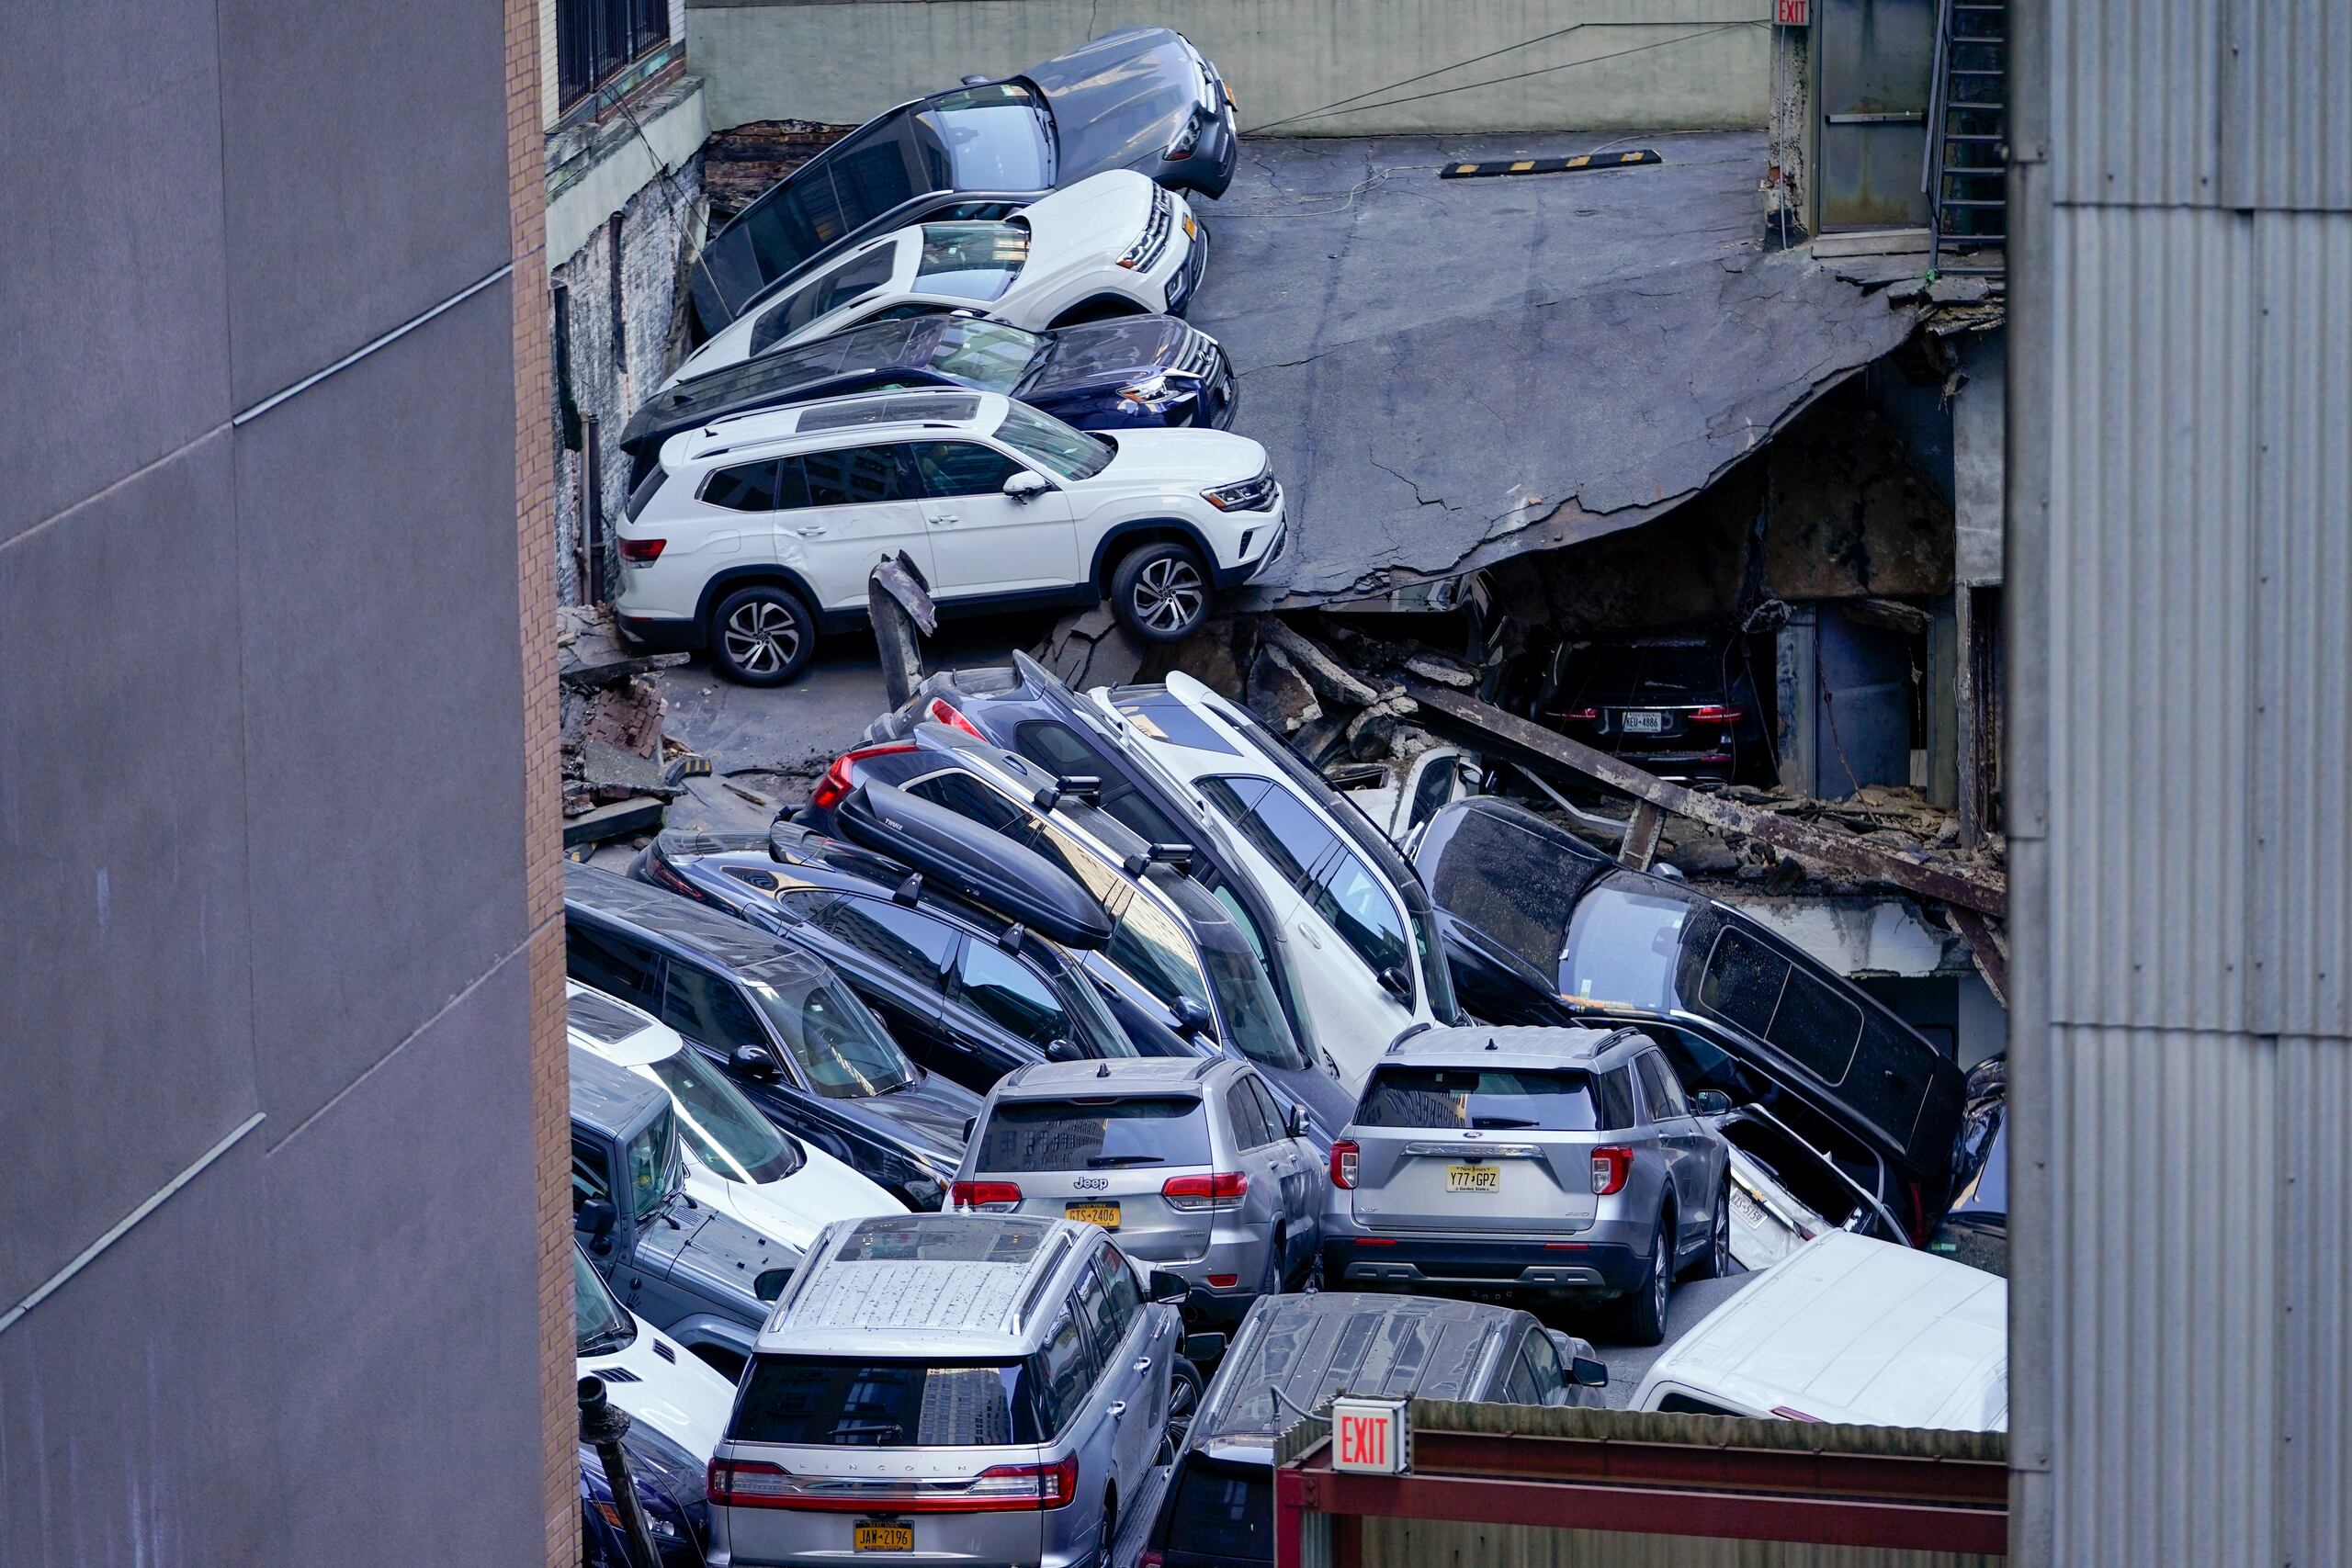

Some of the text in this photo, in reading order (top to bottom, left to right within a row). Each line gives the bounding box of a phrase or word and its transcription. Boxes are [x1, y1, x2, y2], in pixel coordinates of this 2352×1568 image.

[1779, 0, 1805, 22] EXIT
[885, 818, 903, 830] THULE
[1073, 1176, 1109, 1190] Jeep
[1476, 1172, 1497, 1186] GPZ
[1341, 1416, 1388, 1465] EXIT
